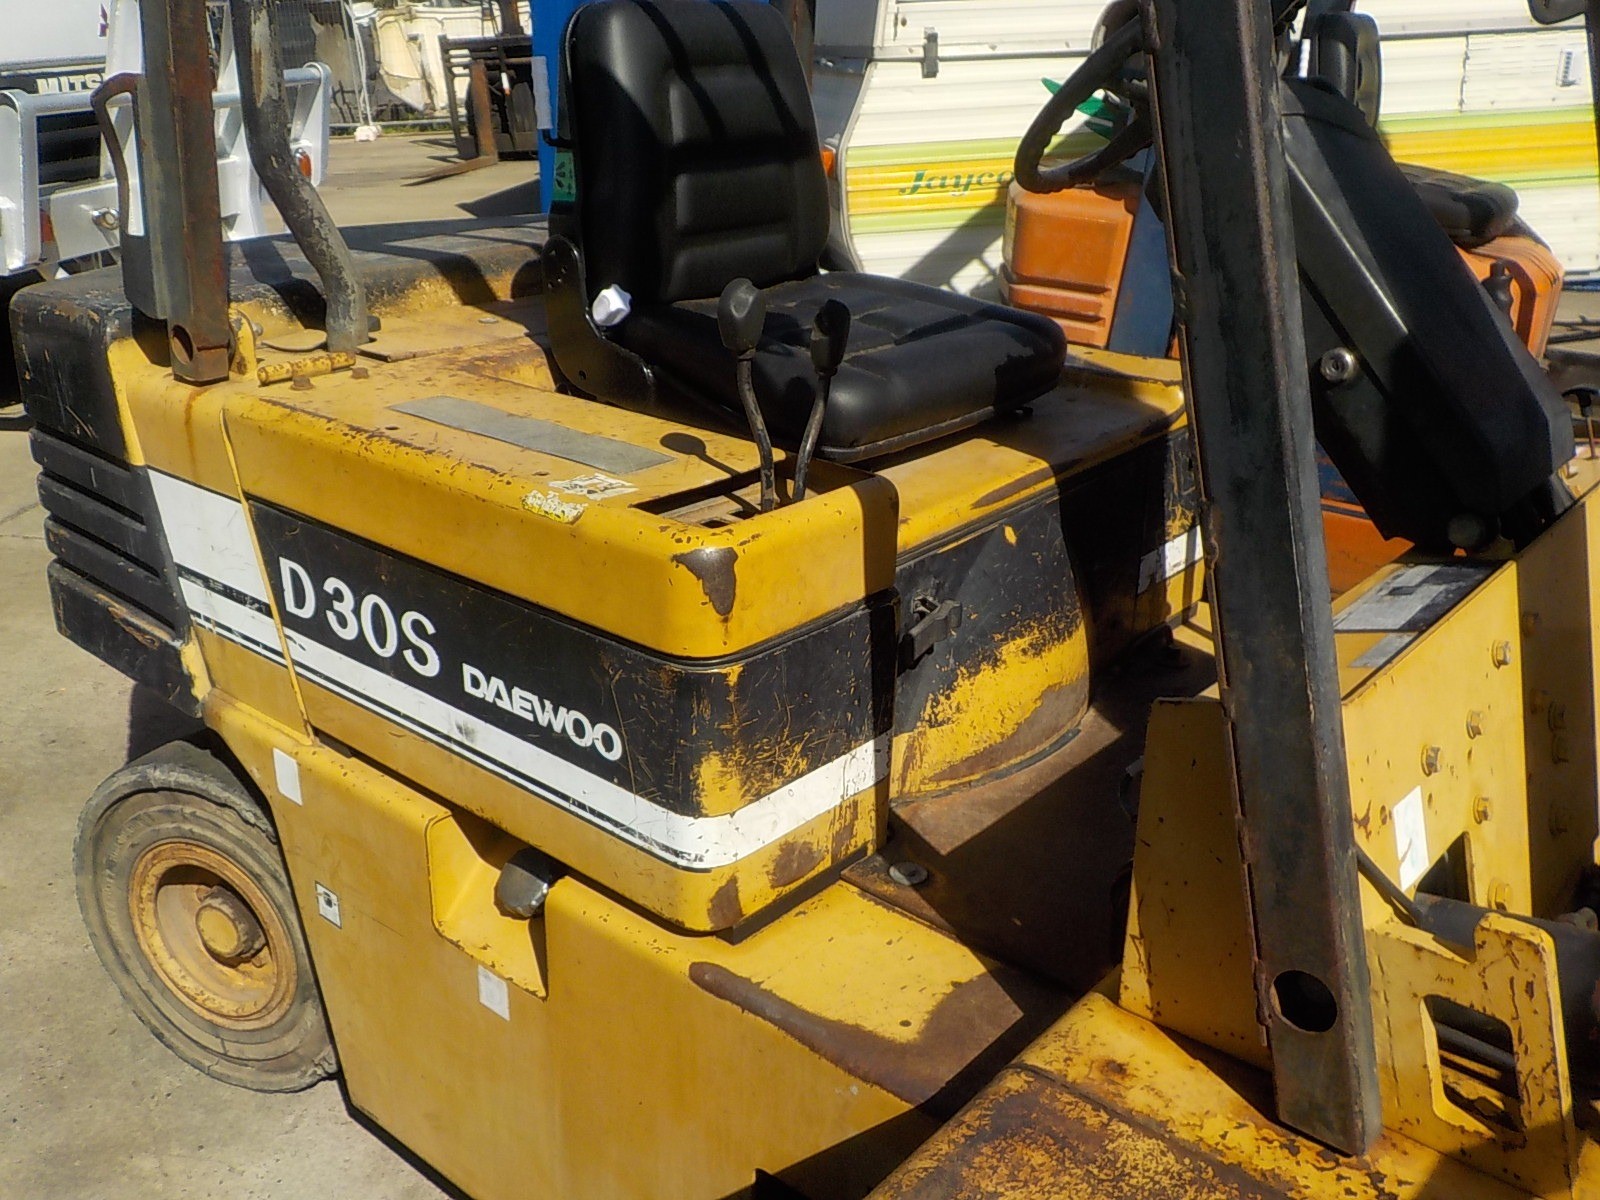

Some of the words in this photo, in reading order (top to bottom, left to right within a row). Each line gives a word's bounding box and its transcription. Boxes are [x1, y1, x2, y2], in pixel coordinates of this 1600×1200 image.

[36, 73, 104, 94] MITS
[898, 169, 1014, 197] Jayco
[462, 662, 622, 762] DAEWOO
